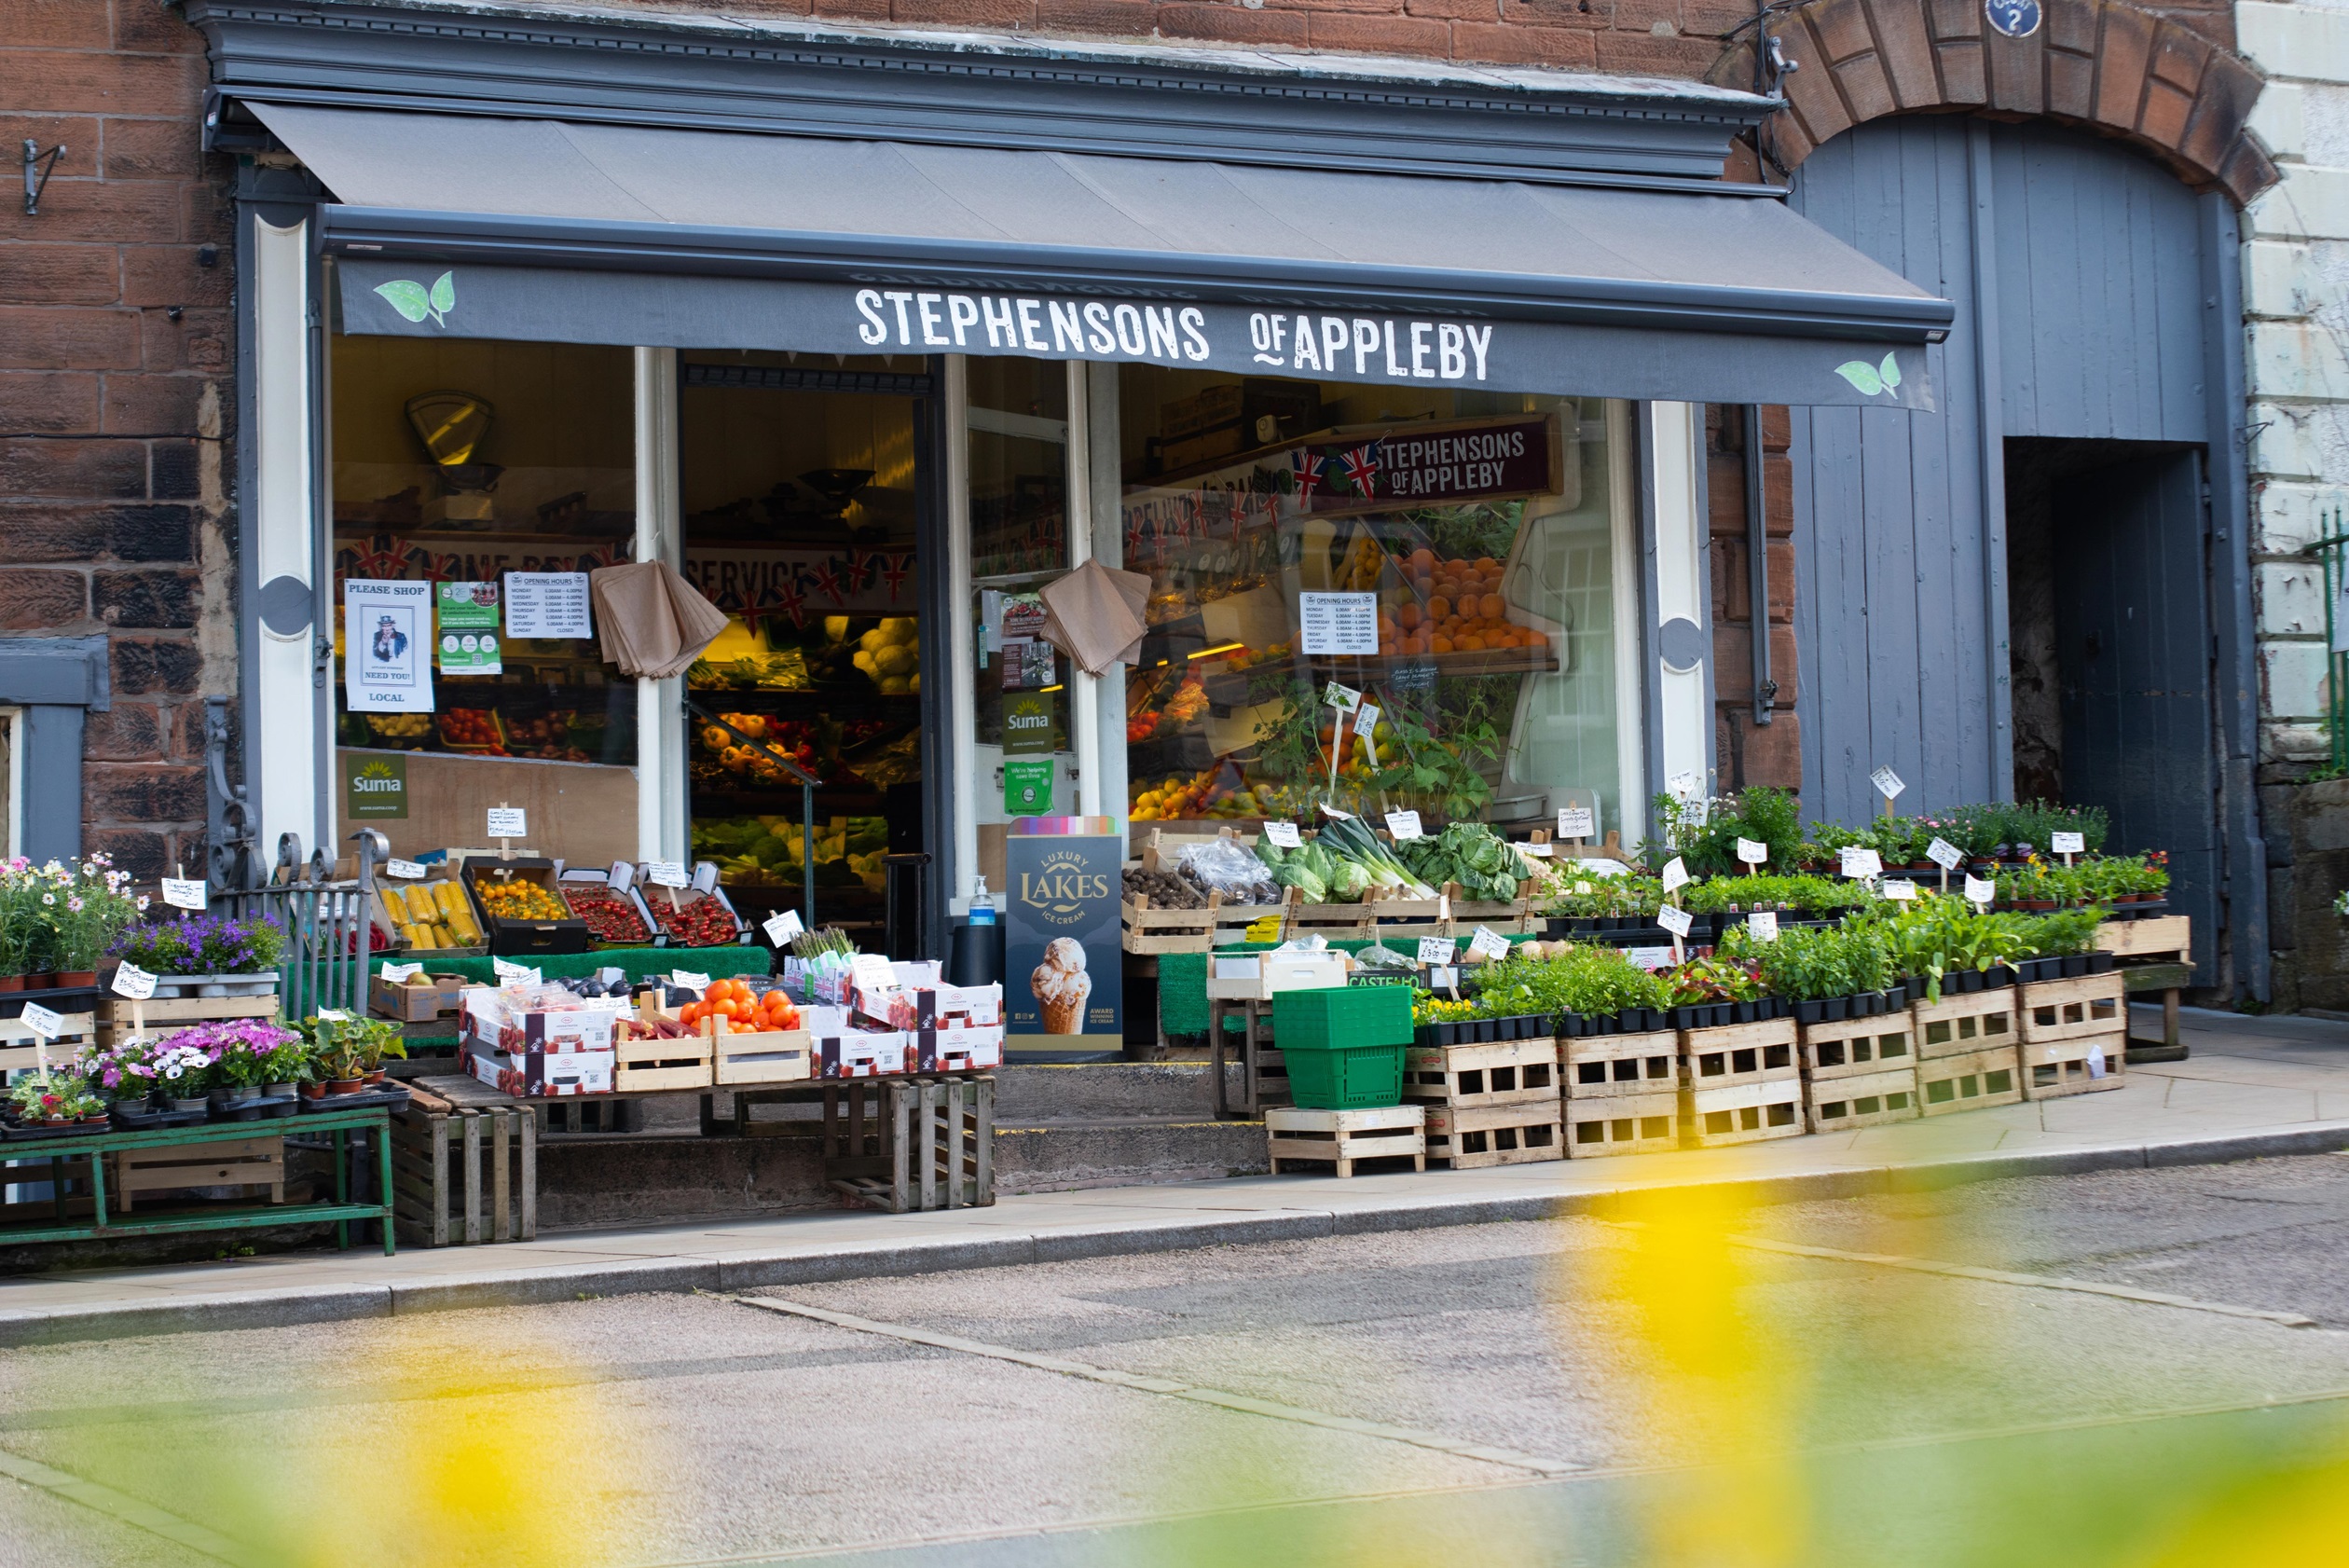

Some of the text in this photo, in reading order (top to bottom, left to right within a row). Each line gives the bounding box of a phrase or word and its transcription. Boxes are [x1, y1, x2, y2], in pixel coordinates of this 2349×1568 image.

[855, 289, 1493, 379] STEPHENSONS OF APPLEBY
[1376, 431, 1525, 471] STEPHENSONS
[1392, 461, 1505, 495] OF APPLEBY
[349, 585, 425, 596] PLEASE SHOP
[391, 672, 410, 681] YOU!
[369, 693, 405, 702] LOCAL
[1008, 714, 1049, 729] Suma
[353, 776, 402, 792] Suma
[1040, 851, 1090, 868] LUXURY
[1020, 873, 1109, 909] LAKES
[1041, 910, 1086, 925] ICE CREAM
